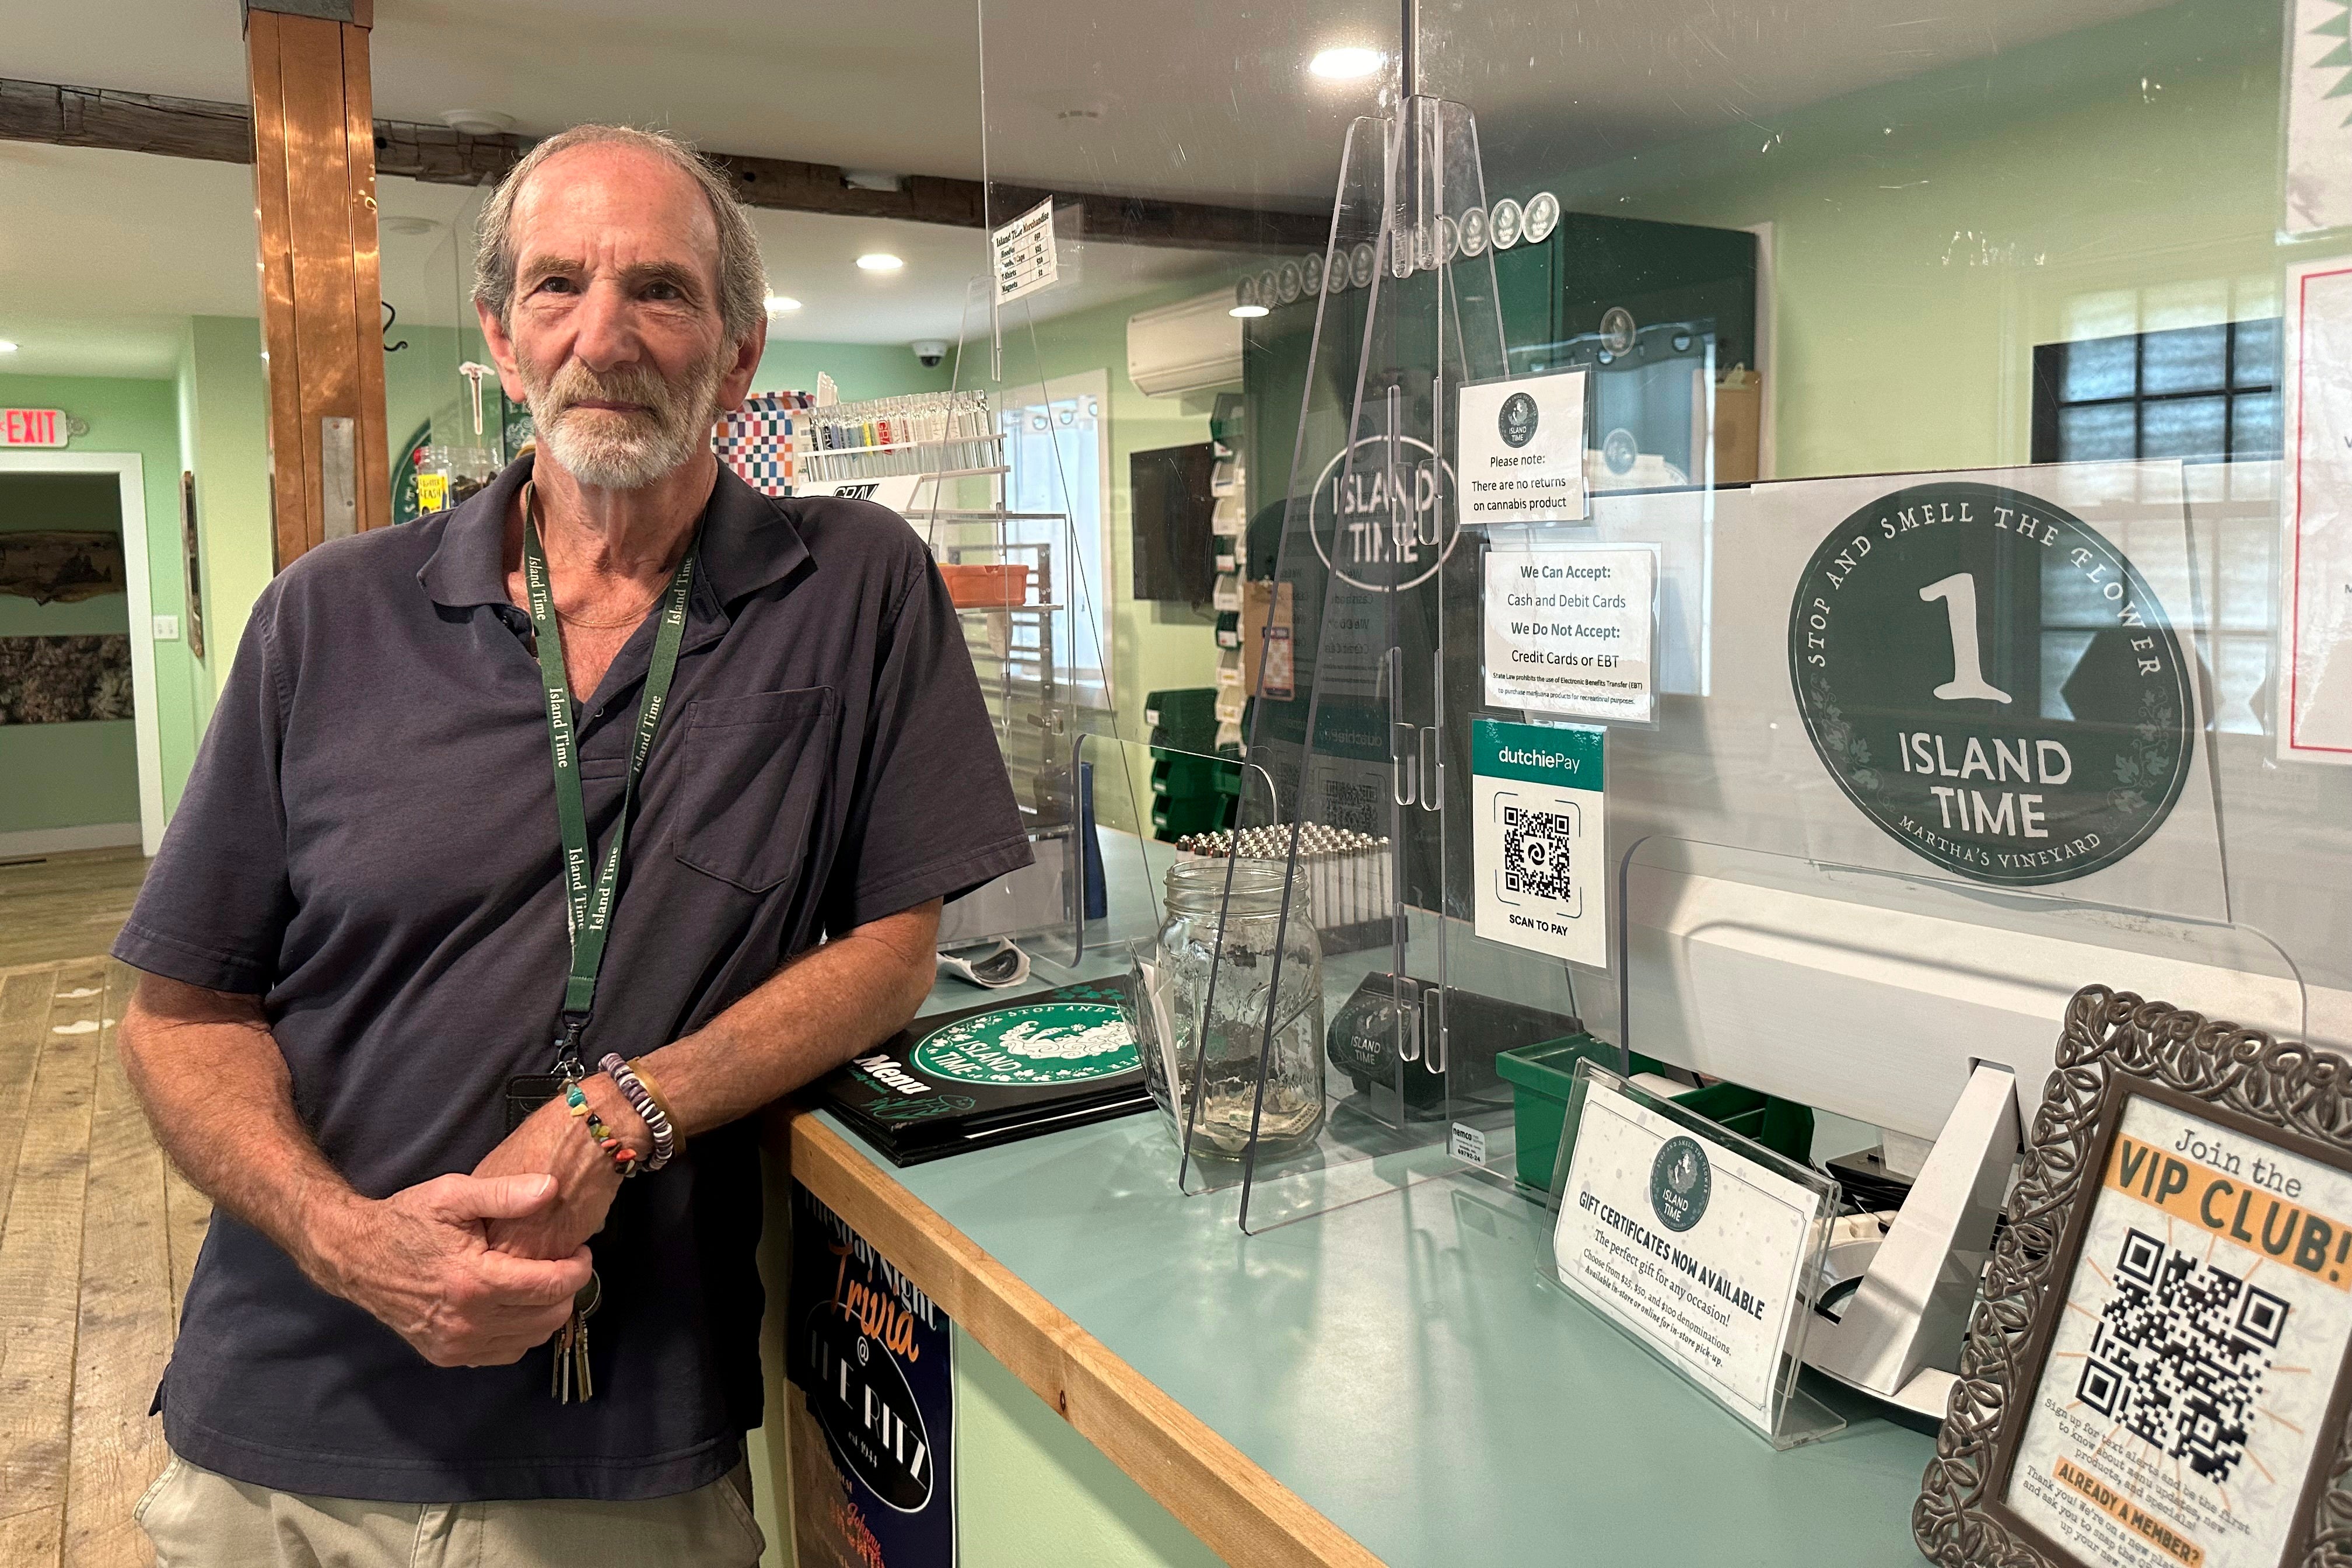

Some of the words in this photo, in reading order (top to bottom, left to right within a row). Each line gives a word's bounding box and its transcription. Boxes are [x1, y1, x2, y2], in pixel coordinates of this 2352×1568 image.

[996, 233, 1010, 247] Island
[1023, 212, 1049, 233] Merchandise
[1002, 269, 1017, 281] T-Shirts
[1002, 281, 1018, 293] Magnets
[6, 410, 57, 443] EXIT
[1509, 426, 1527, 435] ISLAND
[1490, 456, 1518, 467] Please
[1521, 455, 1545, 466] note:
[421, 488, 441, 500] LEASH
[1334, 469, 1434, 514] ISLAND
[1472, 481, 1497, 492] There
[1500, 481, 1514, 490] are
[1517, 479, 1528, 489] no
[1531, 478, 1566, 488] returns
[1474, 502, 1485, 511] on
[1488, 498, 1527, 510] cannabis
[1530, 496, 1566, 510] product
[529, 556, 545, 588] Island
[676, 557, 692, 586] Time
[1521, 566, 1539, 578] We
[1542, 566, 1563, 578] Can
[1566, 566, 1611, 581] Accept:
[532, 589, 547, 621] Time
[667, 584, 687, 625] Island
[1507, 594, 1532, 606] Cash
[1535, 594, 1555, 607] and
[1559, 594, 1589, 607] Debit
[1592, 594, 1626, 608] Cards
[1808, 597, 1830, 667] STOP
[1825, 534, 1872, 590] AND
[1881, 502, 1974, 540] SMELL
[1994, 506, 2059, 547] THE
[2071, 547, 2161, 677] FLOWER
[1511, 622, 1530, 635] We
[1532, 623, 1548, 635] Do
[1551, 624, 1572, 636] Not
[1575, 624, 1620, 640] Accept:
[1919, 572, 2013, 704] 1
[1511, 650, 1544, 663] Credit
[1547, 652, 1578, 666] Cards
[1581, 657, 1593, 666] or
[1597, 655, 1619, 668] EBT
[1629, 681, 1643, 690] (EBT)
[550, 687, 568, 729] Island
[555, 730, 570, 768] Time
[634, 733, 652, 774] Island
[643, 695, 662, 730] Time
[1499, 746, 1580, 774] dutchiePay
[1898, 732, 2071, 785] ISLAND
[1930, 785, 2048, 838] TIME
[1898, 816, 1990, 866] MARTHA'S
[1997, 832, 2101, 869] VINEYARD
[569, 848, 587, 891] Island
[589, 887, 611, 932] Island
[601, 846, 618, 884] Time
[574, 893, 588, 931] Time
[1510, 914, 1534, 929] SCAN
[1536, 920, 1549, 932] TO
[1552, 925, 1568, 936] PAY
[1008, 1006, 1055, 1017] STOP
[955, 1041, 1022, 1072] ISLAND
[1350, 1035, 1381, 1054] ISLAND
[1354, 1049, 1376, 1065] TIME
[853, 1054, 932, 1094] Menu
[936, 1051, 972, 1075] TIME
[1453, 1128, 1472, 1140] nemco
[2176, 1129, 2240, 1175] Join
[2253, 1158, 2302, 1198] the
[1662, 1188, 1689, 1212] ISLAND
[1664, 1203, 1681, 1222] TIME
[2120, 1139, 2189, 1205] VIP
[2200, 1179, 2352, 1283] CLUB!
[1580, 1191, 1600, 1215] GIFT
[1601, 1205, 1670, 1260] CERTIFICATES
[1671, 1248, 1698, 1278] NOW
[1698, 1266, 1765, 1320] AVAILABLE
[1595, 1229, 1609, 1247] The
[1609, 1242, 1639, 1266] perfect
[1639, 1261, 1654, 1277] gift
[1656, 1269, 1668, 1286] for
[1670, 1282, 1686, 1300] any
[1687, 1293, 1731, 1326] occasion!
[829, 1240, 919, 1363] Trivia
[1584, 1248, 1605, 1269] Choose
[1605, 1262, 1620, 1280] from
[1621, 1275, 1633, 1289] $25,
[1634, 1284, 1647, 1300] $50,
[1648, 1294, 1660, 1307] and
[1662, 1301, 1676, 1317] $100
[1677, 1311, 1731, 1356] denominations.
[1585, 1265, 1611, 1289] Available
[1612, 1282, 1633, 1301] in-store
[1642, 1306, 1660, 1322] online
[1660, 1317, 1670, 1329] for
[1671, 1323, 1695, 1347] in-store
[1695, 1343, 1722, 1367] pick-up.
[857, 1336, 869, 1366] @
[865, 1384, 927, 1490] RITZ
[2045, 1398, 2067, 1419] Sign
[2070, 1416, 2081, 1429] up
[2083, 1422, 2099, 1438] for
[2102, 1434, 2123, 1455] text
[2126, 1450, 2159, 1476] alerts
[2161, 1472, 2181, 1491] and
[2183, 1483, 2196, 1500] be
[2199, 1494, 2217, 1514] the
[2219, 1508, 2250, 1535] first
[2059, 1422, 2069, 1433] to
[2071, 1428, 2095, 1450] know
[2096, 1447, 2124, 1470] about
[2127, 1467, 2152, 1489] menu
[2156, 1488, 2200, 1521] updates,
[2203, 1516, 2225, 1534] new
[2075, 1448, 2122, 1485] products,
[2124, 1480, 2144, 1497] and
[2146, 1493, 2196, 1531] specials!
[2058, 1463, 2119, 1510] ALREADY
[2118, 1503, 2129, 1520] A
[2130, 1509, 2200, 1566] MEMBER?
